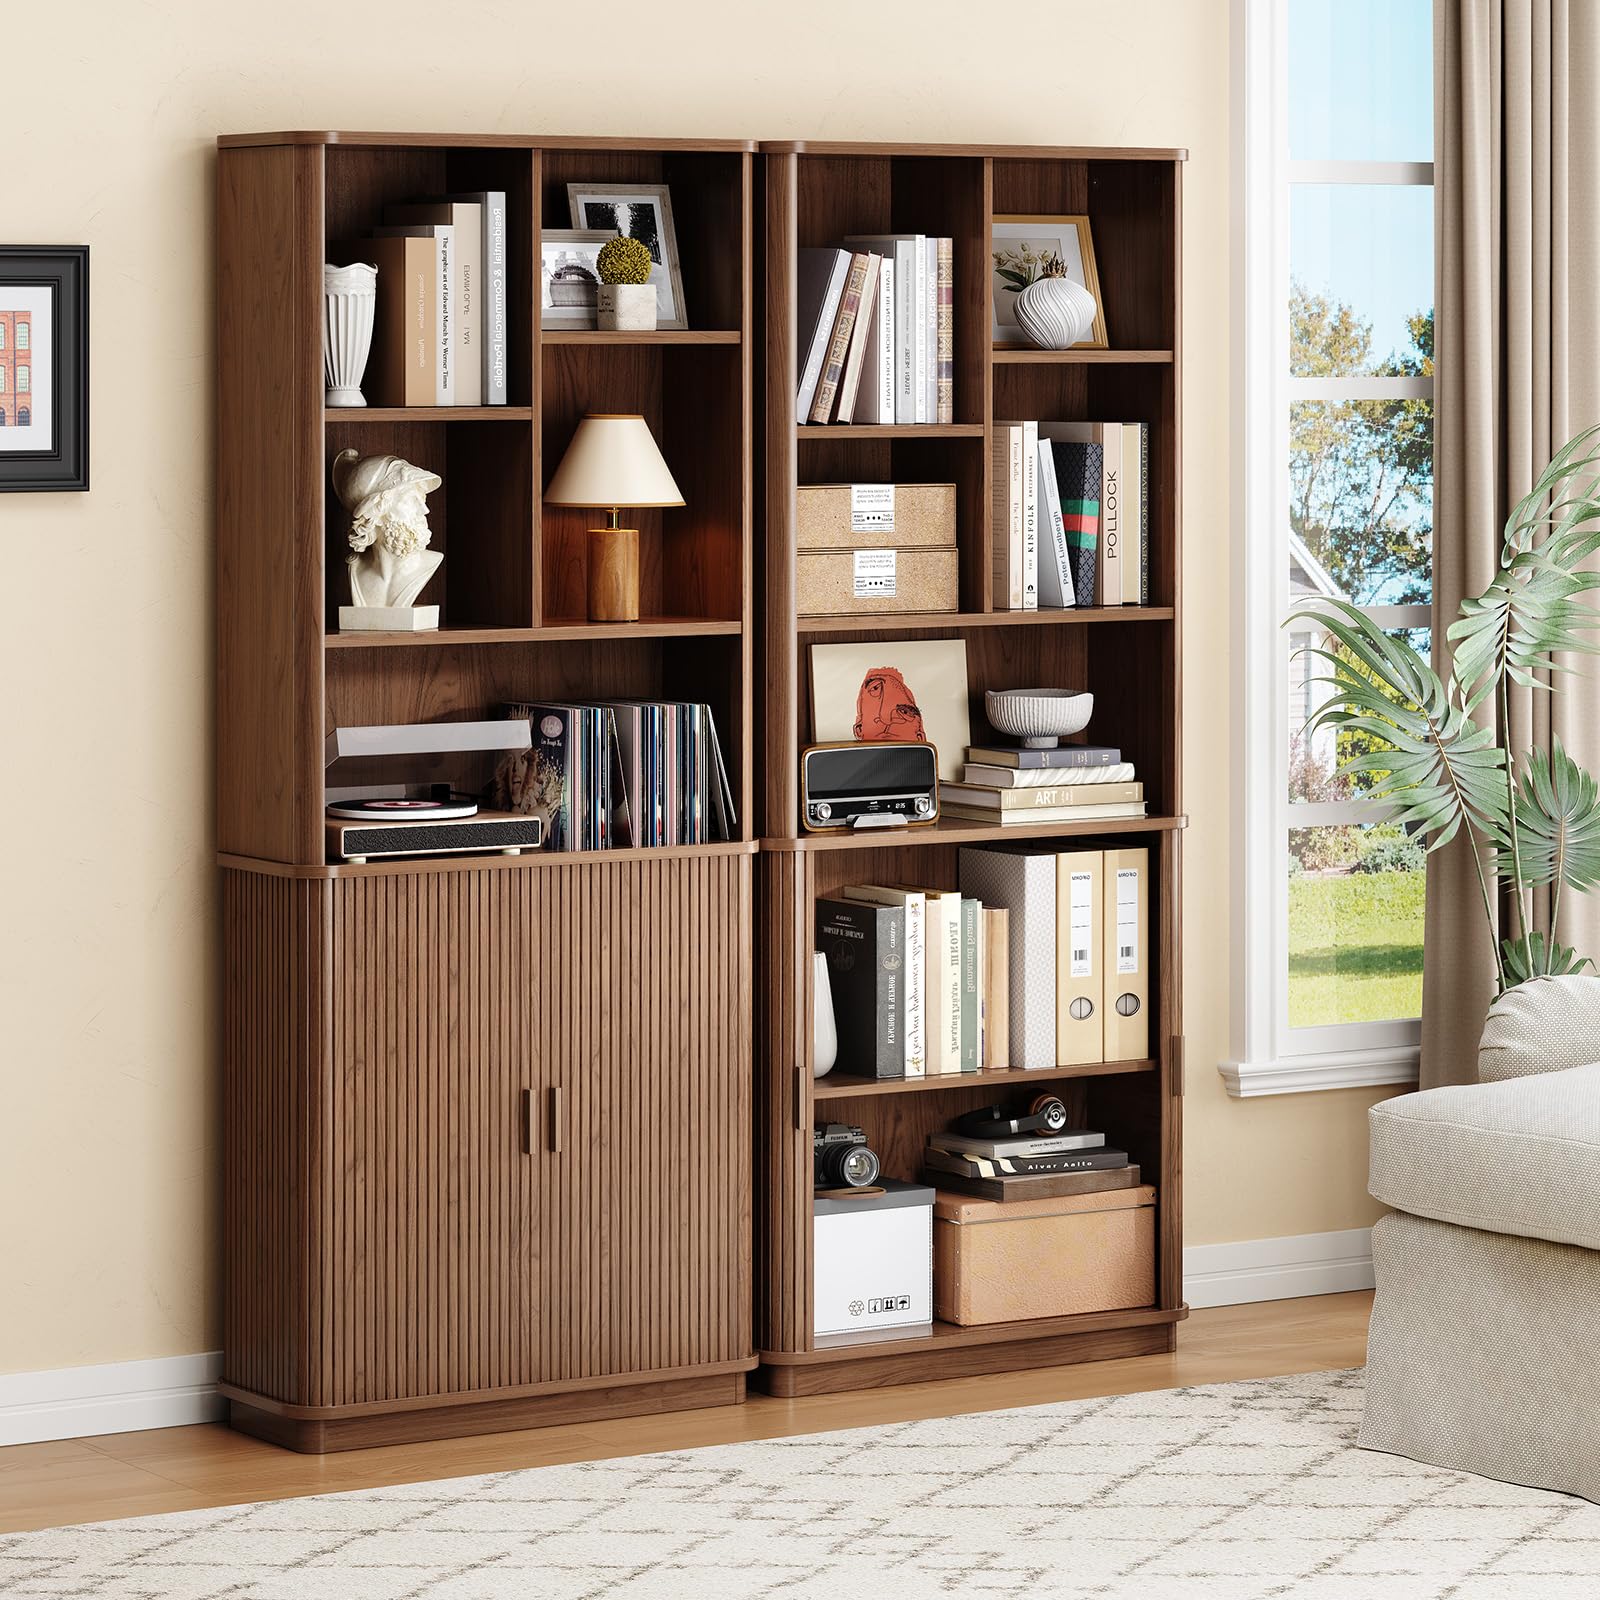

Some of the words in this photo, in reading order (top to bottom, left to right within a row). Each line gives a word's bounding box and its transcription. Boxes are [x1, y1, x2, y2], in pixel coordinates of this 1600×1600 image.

[442, 338, 448, 346] by
[1107, 471, 1117, 558] POLLOCK
[1053, 511, 1065, 558] Lindbergh
[1060, 561, 1070, 585] Peter
[1035, 790, 1057, 805] ART
